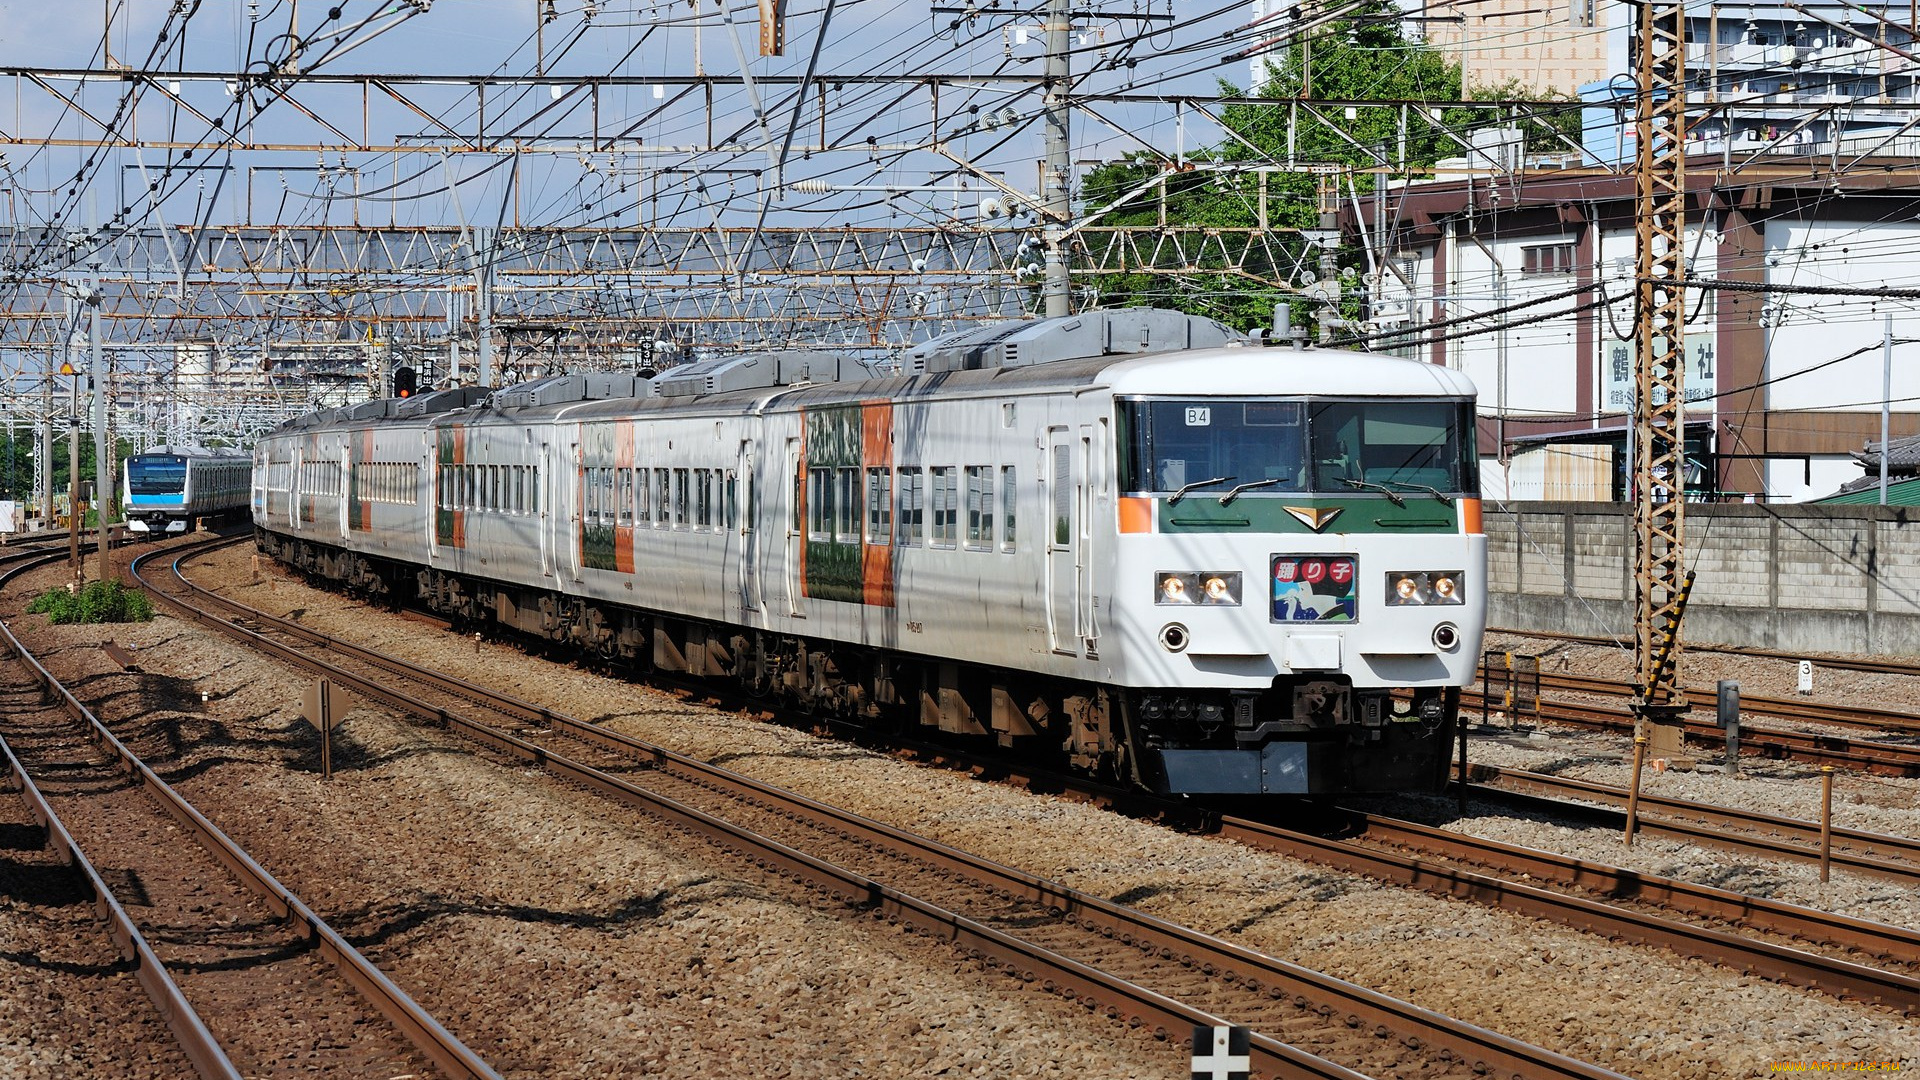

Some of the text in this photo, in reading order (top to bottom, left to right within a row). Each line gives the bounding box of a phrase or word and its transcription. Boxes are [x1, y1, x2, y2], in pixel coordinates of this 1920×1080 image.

[1188, 409, 1207, 424] B4
[1276, 562, 1351, 580] 踊り子
[1802, 663, 1811, 675] 3
